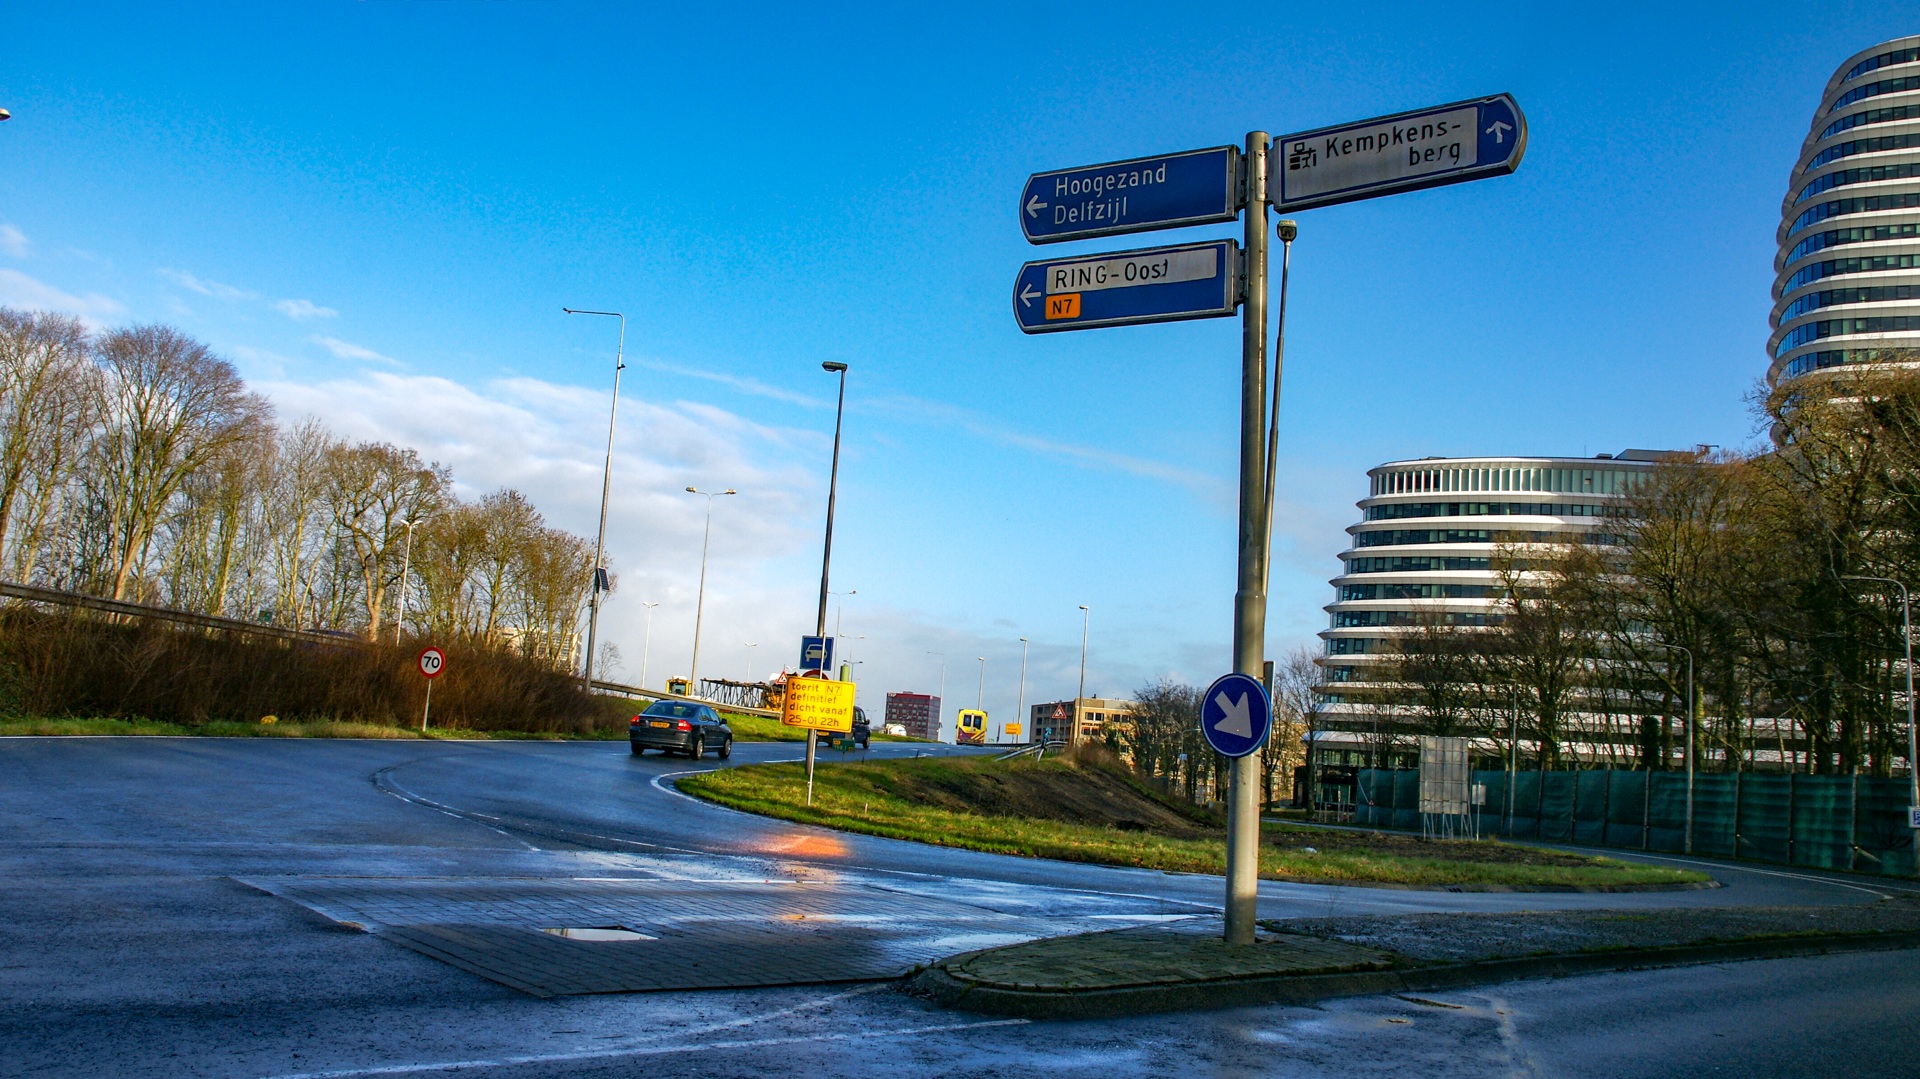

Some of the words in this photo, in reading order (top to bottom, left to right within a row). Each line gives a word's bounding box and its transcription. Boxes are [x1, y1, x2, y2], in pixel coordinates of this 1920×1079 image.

[1326, 121, 1461, 158] Kempkens-
[1409, 142, 1461, 166] berg
[1055, 163, 1166, 198] Hoogezand
[1054, 196, 1127, 225] Delfzijl
[1055, 259, 1168, 289] RING-Oost
[1052, 299, 1073, 315] N7
[423, 656, 440, 669] 70
[791, 682, 819, 692] toerit
[826, 685, 841, 694] N7
[790, 692, 837, 704] definitief
[789, 702, 816, 713] dicht
[819, 707, 848, 716] vanaf
[788, 714, 817, 725] 25-01
[820, 717, 839, 727] 22h
